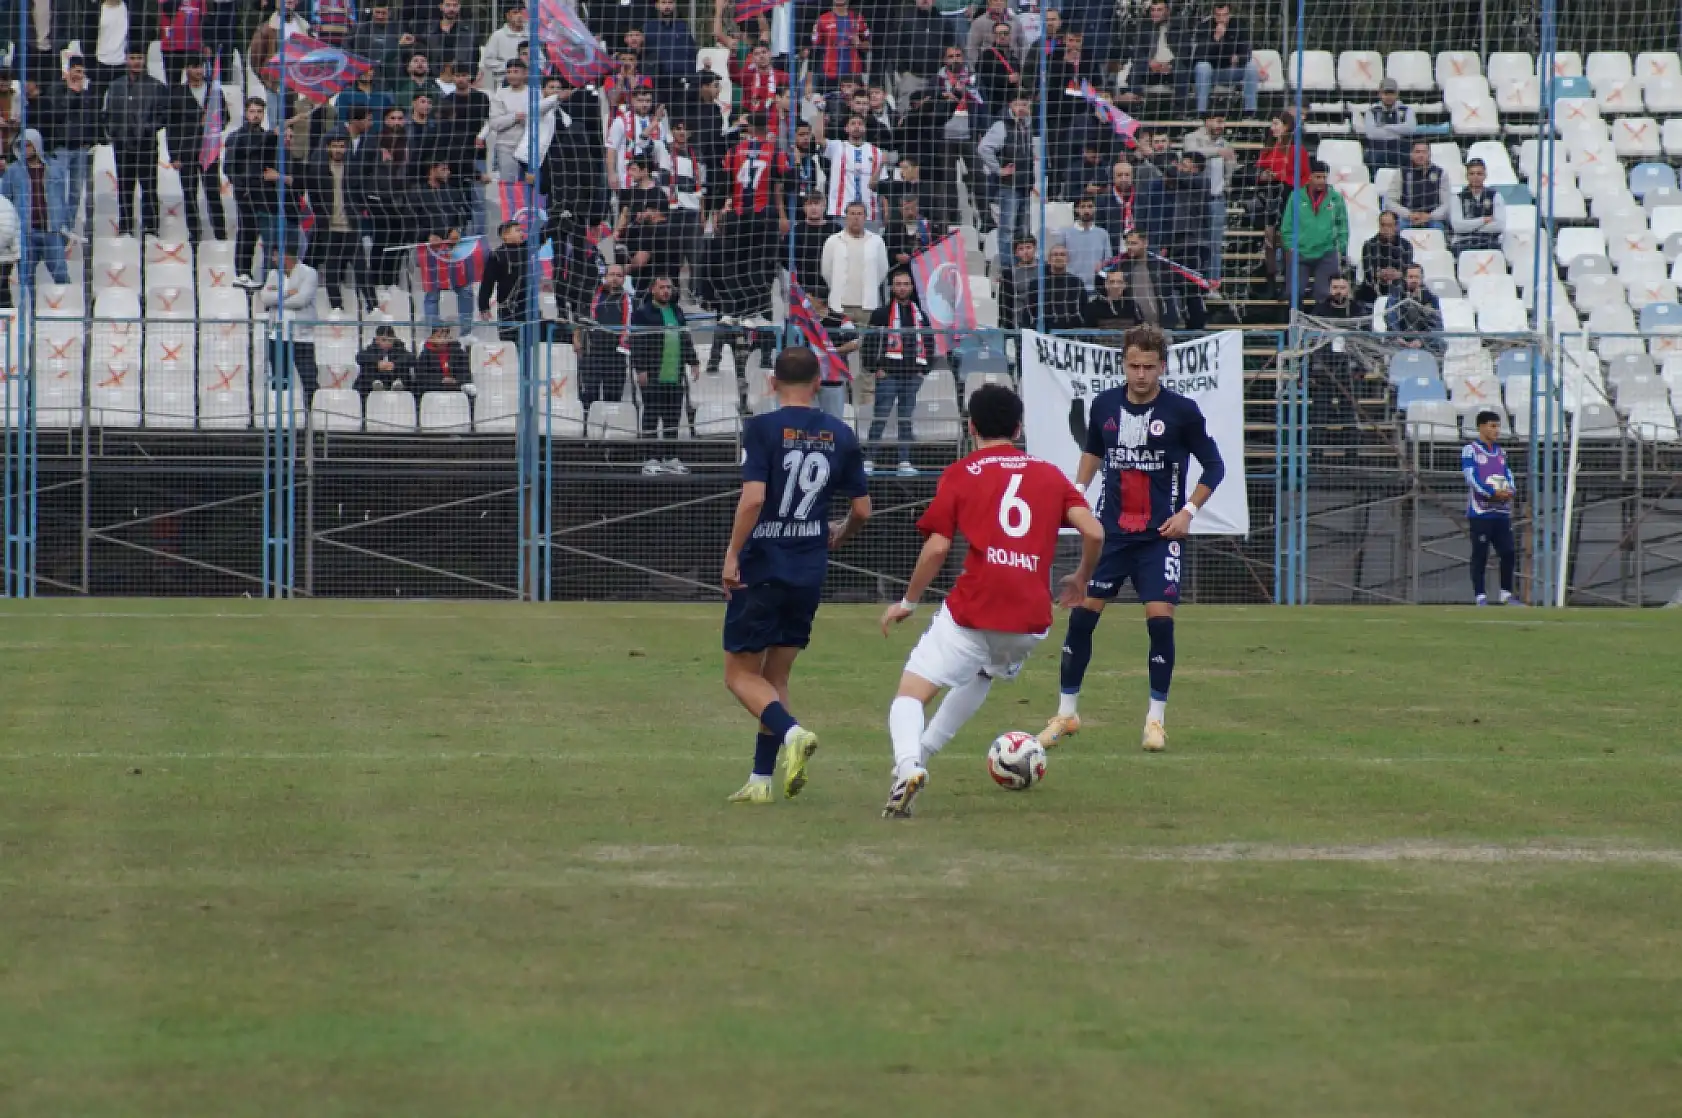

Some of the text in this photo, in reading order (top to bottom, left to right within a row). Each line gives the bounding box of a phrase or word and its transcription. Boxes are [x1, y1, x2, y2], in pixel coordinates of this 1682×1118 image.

[737, 160, 767, 189] 47
[1035, 337, 1085, 374] ALLAH
[1091, 349, 1125, 376] VAR
[1175, 342, 1209, 375] YOK
[1107, 447, 1165, 462] ESNAF
[778, 450, 831, 520] 19
[998, 473, 1033, 537] 6
[987, 546, 1040, 572] ROJHAT
